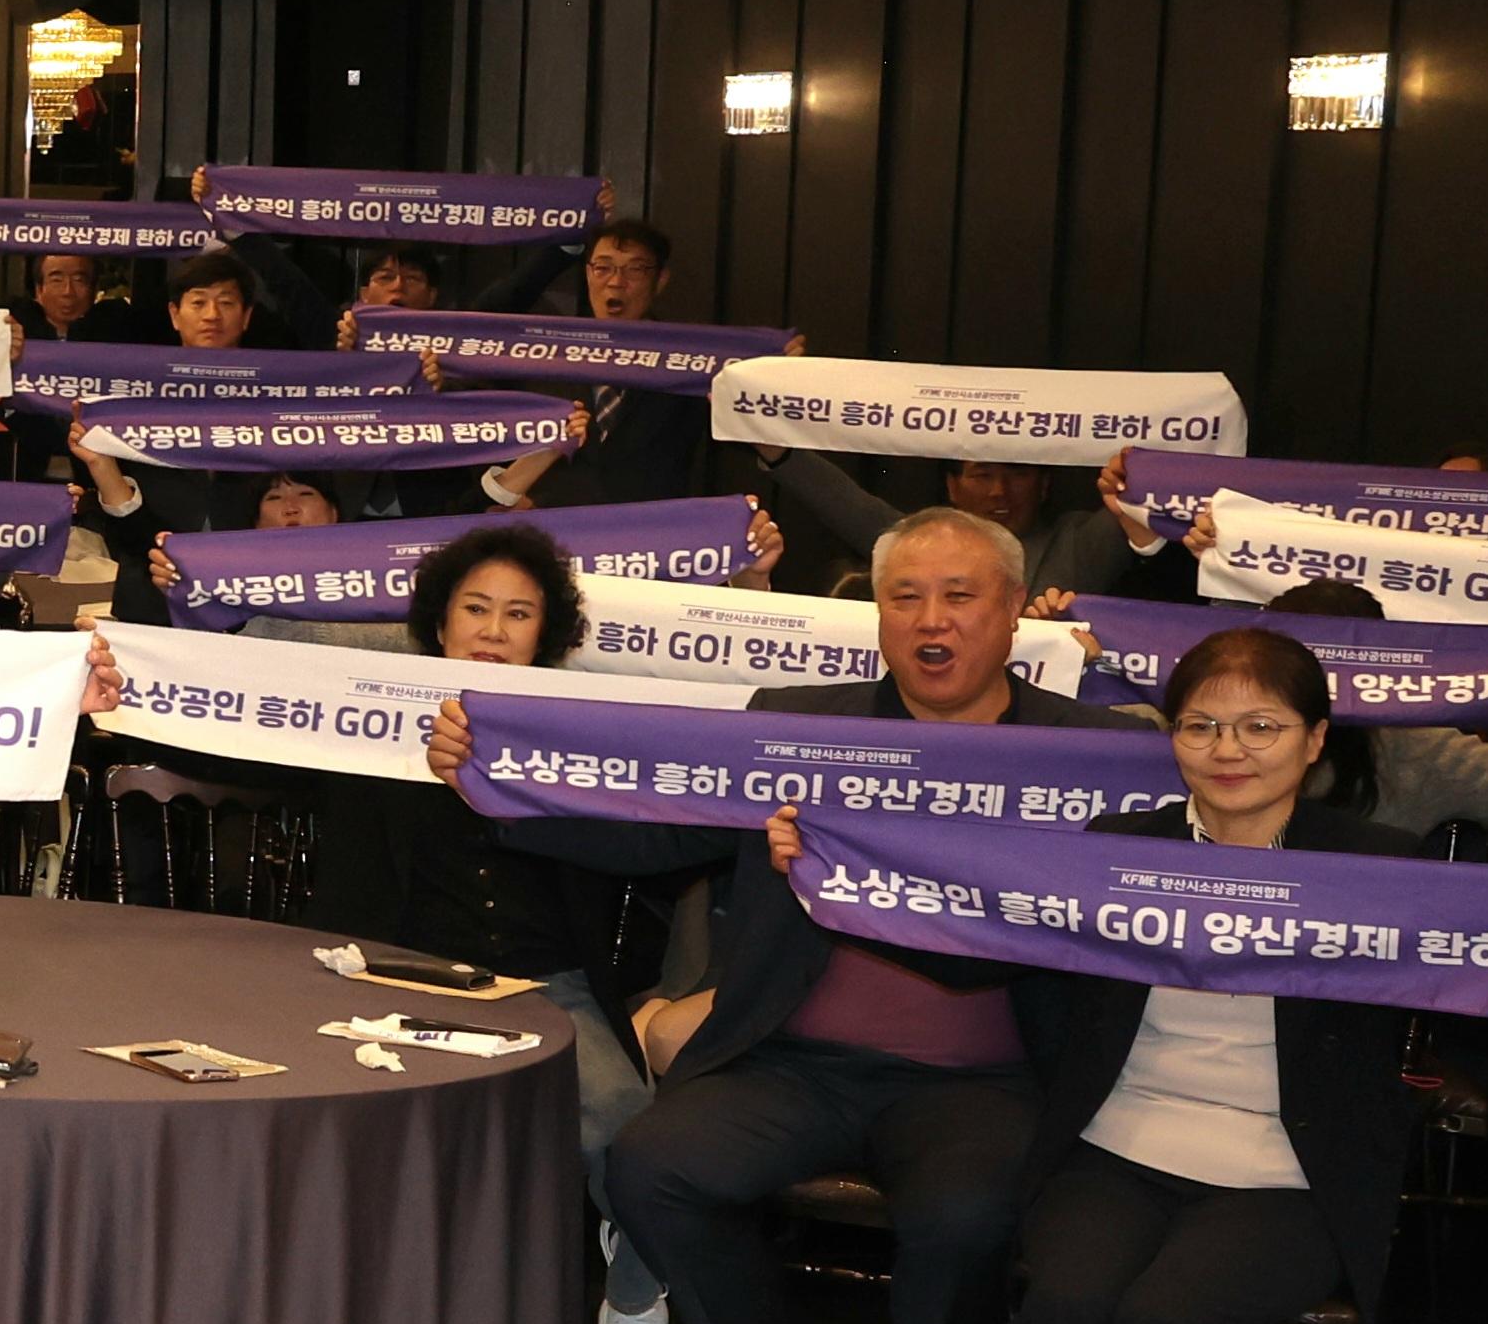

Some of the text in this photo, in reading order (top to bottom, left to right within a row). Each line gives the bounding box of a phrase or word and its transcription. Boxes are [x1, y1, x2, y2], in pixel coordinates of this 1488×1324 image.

[216, 194, 586, 227] 소상공인 흥하 GO! 양산경제 환하 GO!
[211, 420, 567, 447] 흥하 GO! 양산경제 환하 GO!
[734, 391, 1220, 441] 소상공인 흥하 GO! 양산경제 환하 GO!
[596, 622, 879, 679] 흥하 GO! 양산경제
[118, 678, 403, 741] 소상공인 흥하 GO!
[489, 748, 1106, 821] 소상공인 흥하 GO! 양산경제 환하
[819, 865, 1399, 960] 소상공인 흥하 GO! 양산경제
